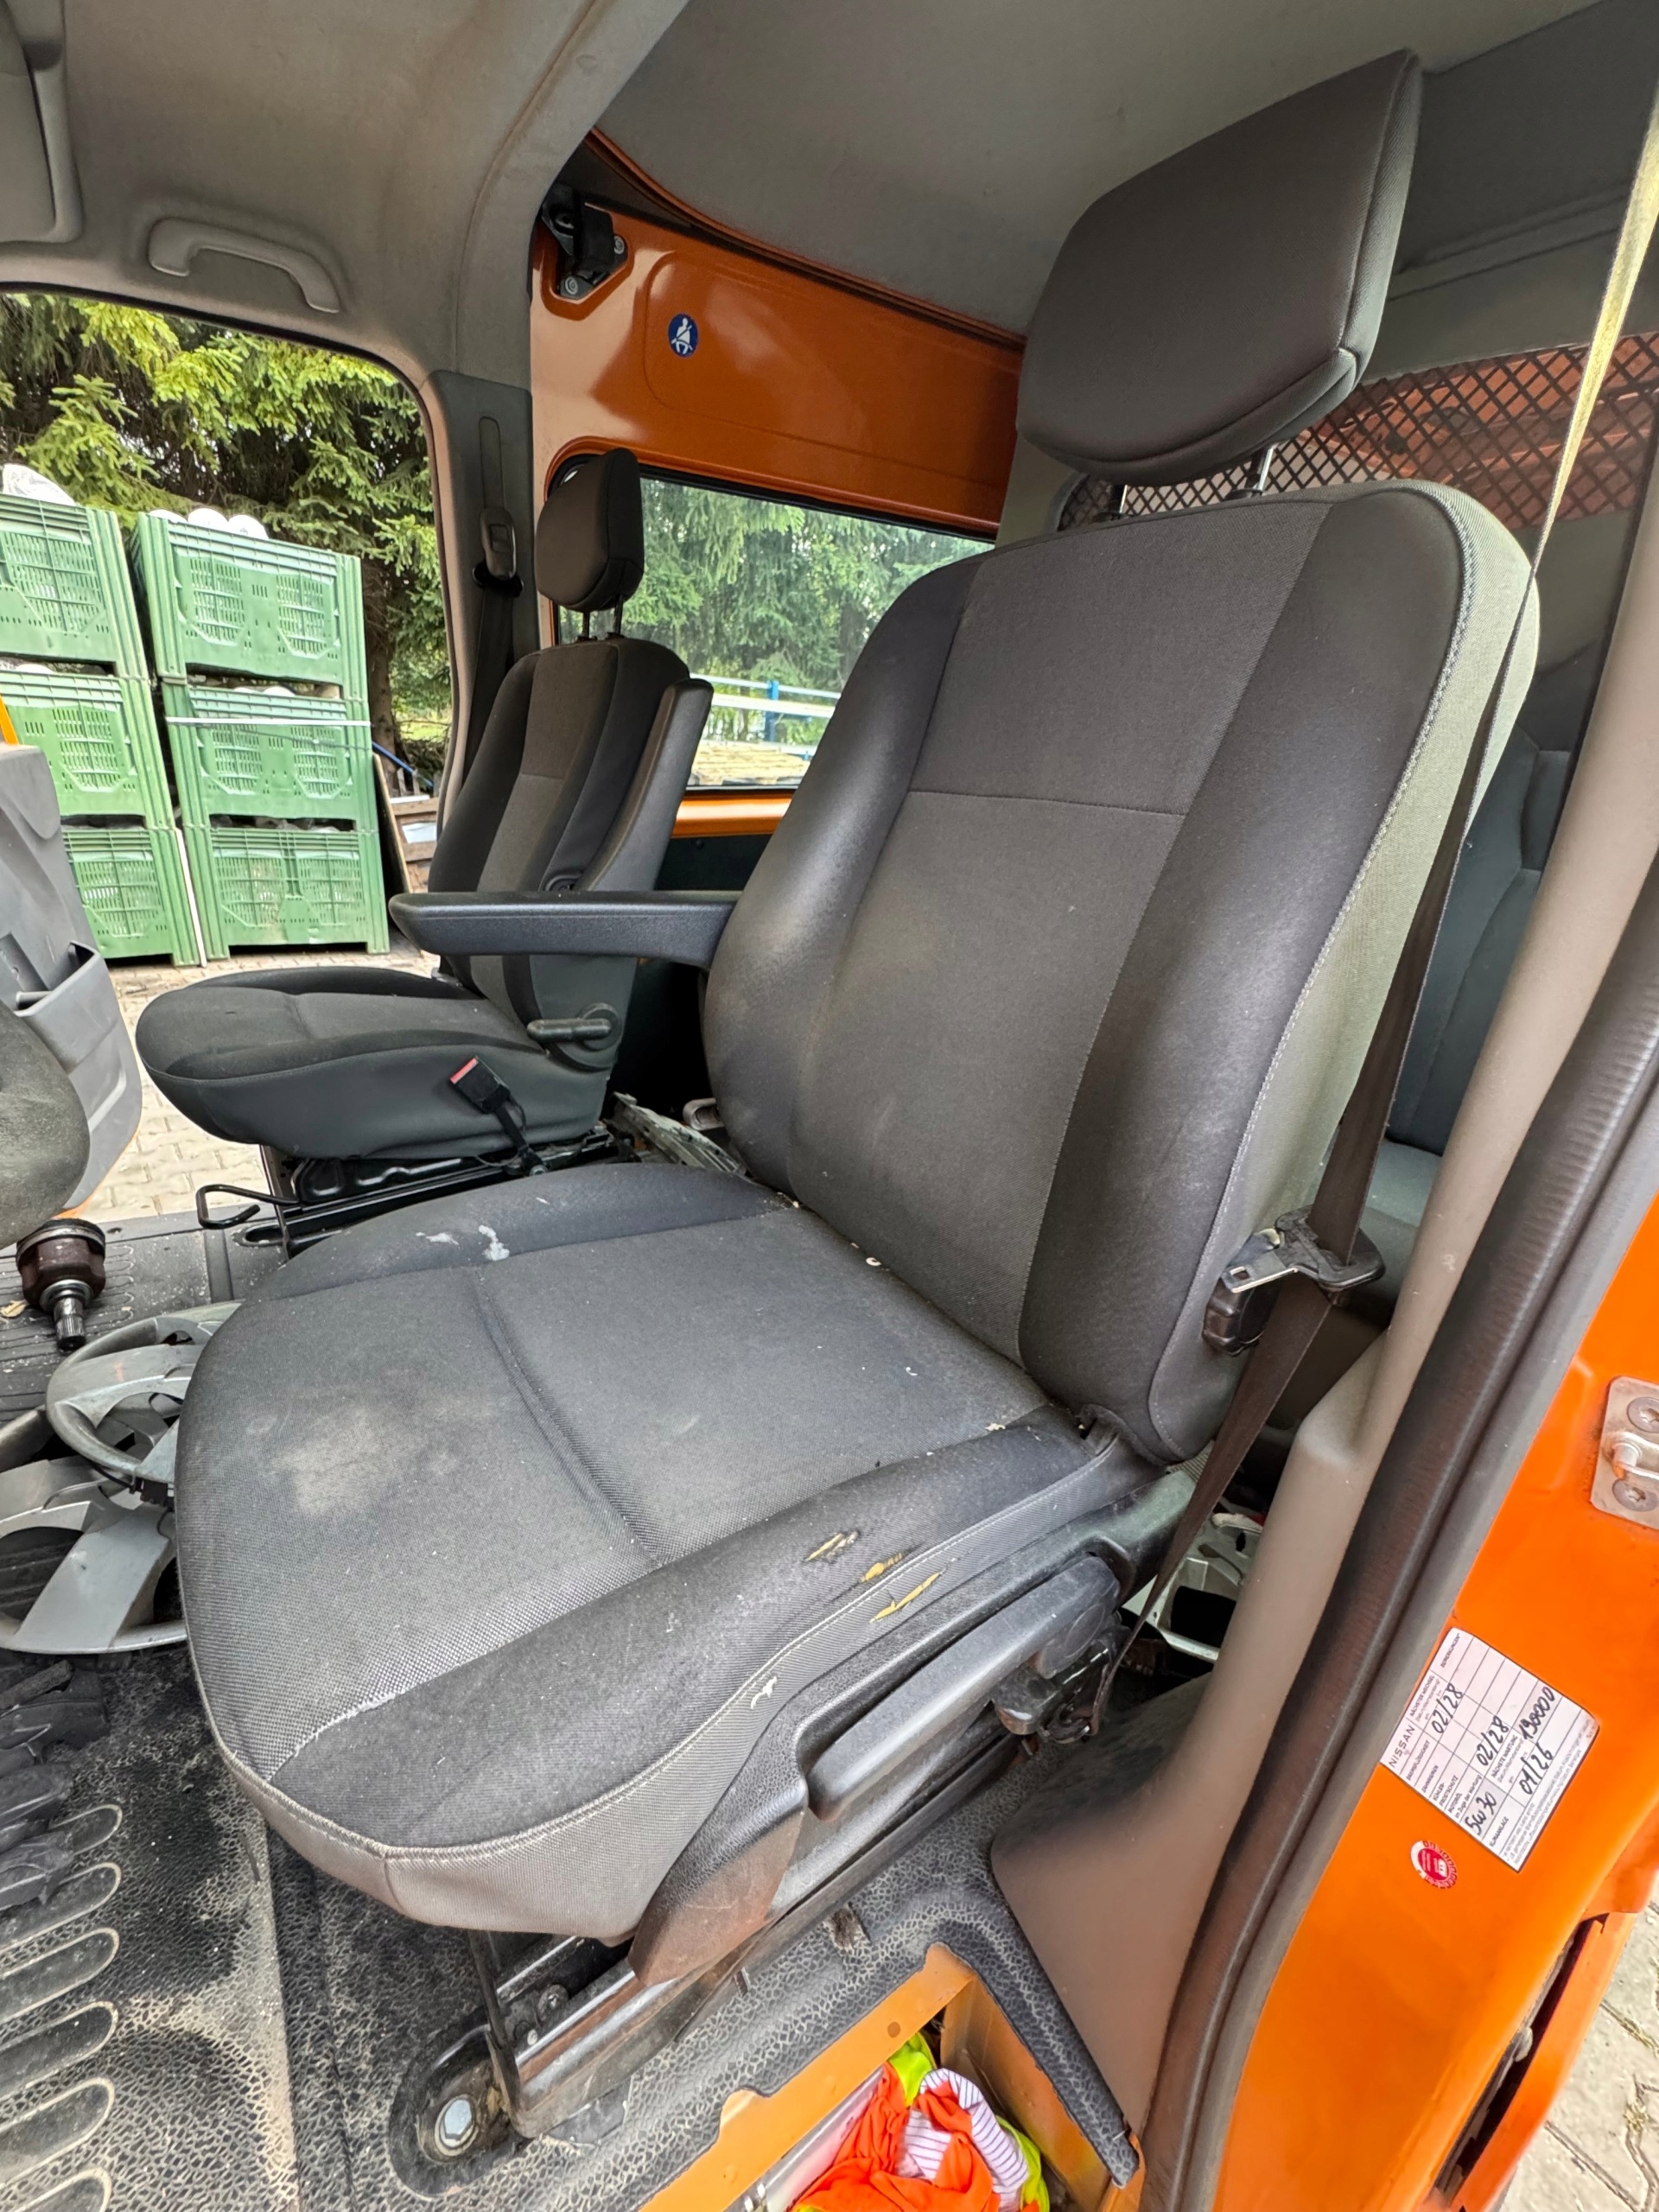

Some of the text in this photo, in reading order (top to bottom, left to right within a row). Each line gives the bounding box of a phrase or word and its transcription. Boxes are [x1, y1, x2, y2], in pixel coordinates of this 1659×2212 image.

[1431, 1682, 1463, 1734] 02/28
[1388, 1724, 1415, 1769] NISSAN
[1476, 1715, 1509, 1766] 02/28
[1439, 1774, 1459, 1807] FROSTSCHUTZ
[1519, 1741, 1554, 1795] 01/26
[1476, 1791, 1497, 1815] 30
[1488, 1815, 1509, 1847] KLIMAANLAGE
